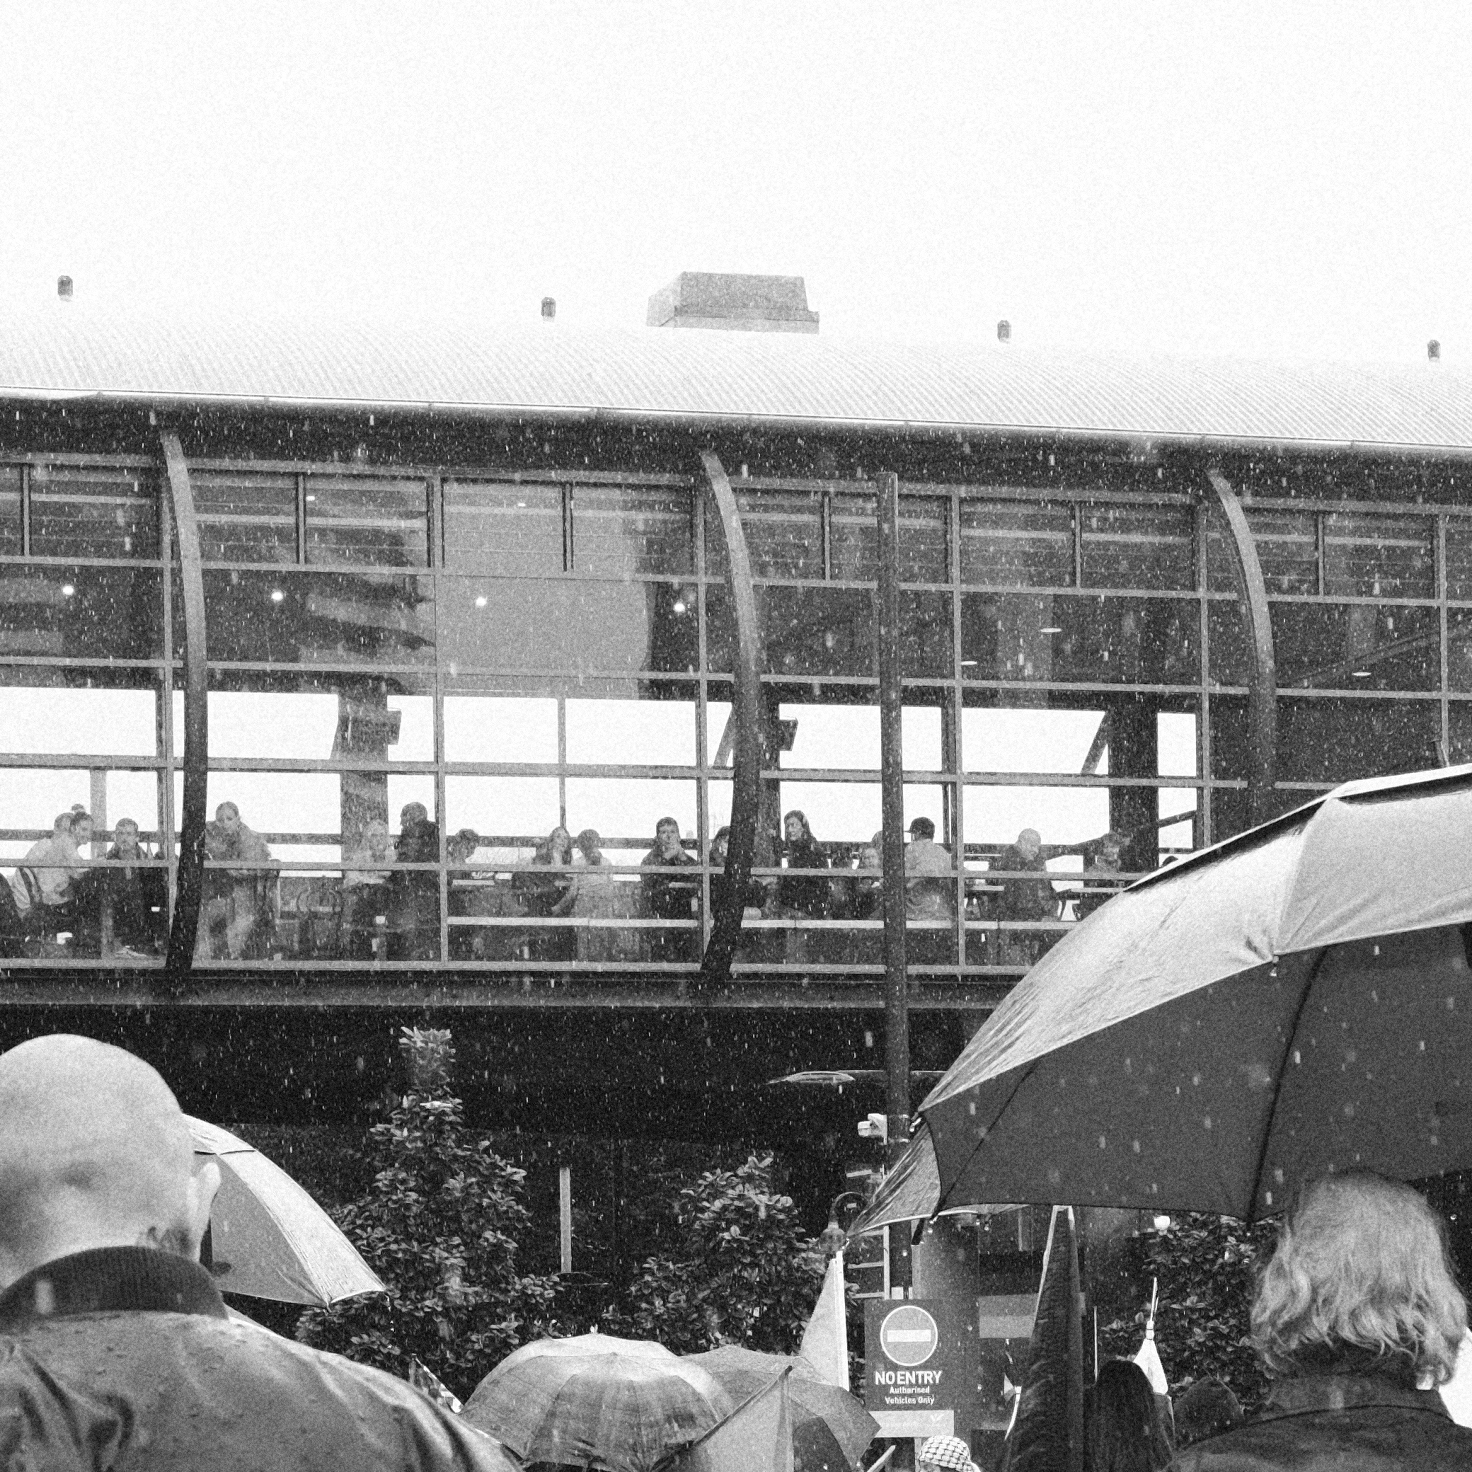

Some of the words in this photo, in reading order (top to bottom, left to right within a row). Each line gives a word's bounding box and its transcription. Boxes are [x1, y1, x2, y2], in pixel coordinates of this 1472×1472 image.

[874, 1370, 896, 1385] NO
[896, 1370, 943, 1385] ENTRY
[889, 1385, 930, 1395] Authorised
[884, 1396, 917, 1405] Vehicles
[917, 1395, 935, 1406] Only
